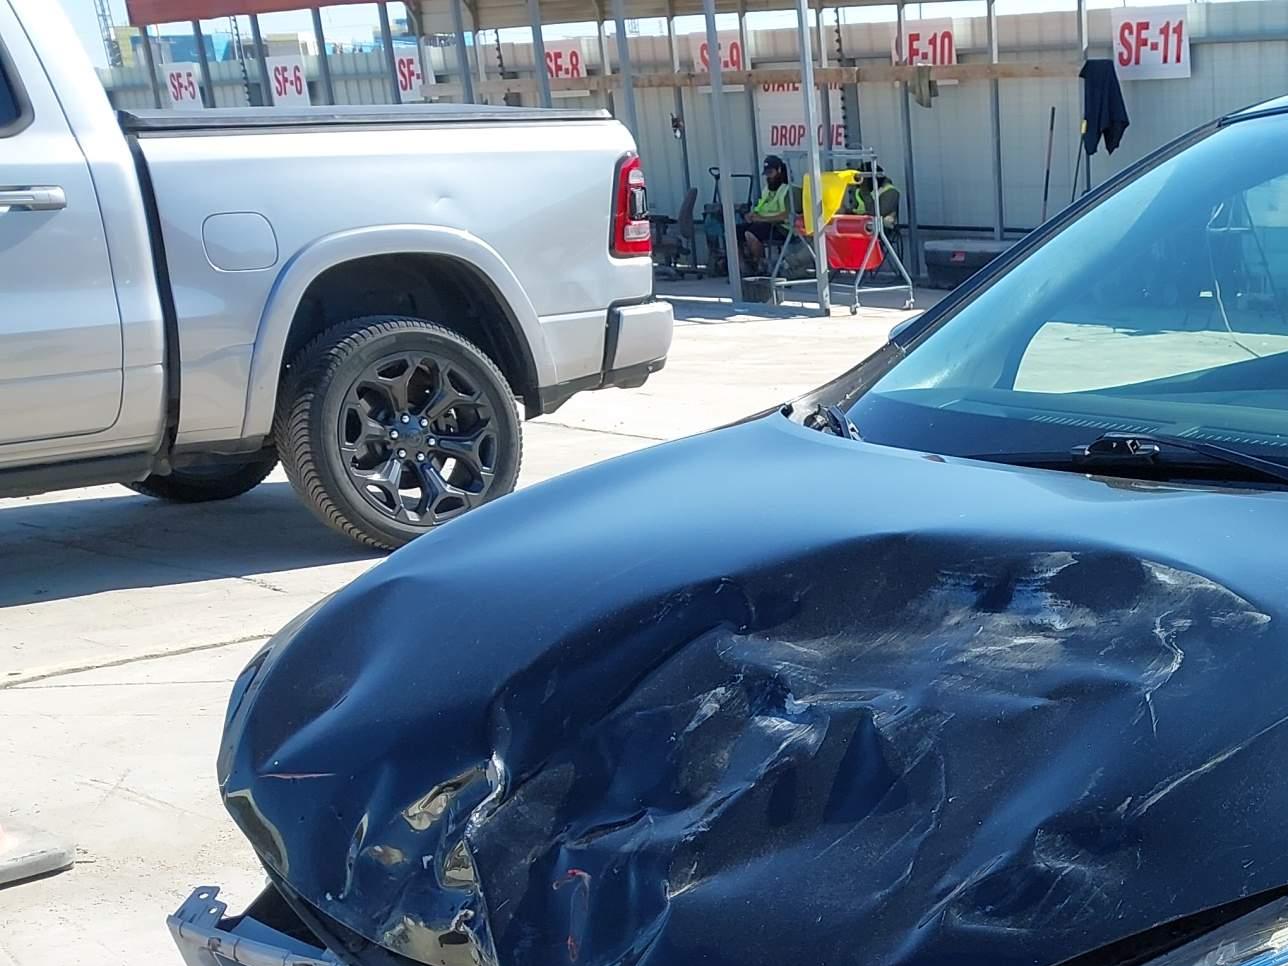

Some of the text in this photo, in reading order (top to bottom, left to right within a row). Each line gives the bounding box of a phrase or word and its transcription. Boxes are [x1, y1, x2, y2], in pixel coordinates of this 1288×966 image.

[700, 41, 741, 71] S-9
[895, 30, 953, 65] F-10
[1118, 20, 1184, 66] SF-11
[398, 57, 425, 92] SF-
[545, 50, 581, 78] SF-8
[169, 71, 196, 101] SF-5
[273, 65, 303, 96] SF-6
[770, 124, 806, 146] DROP
